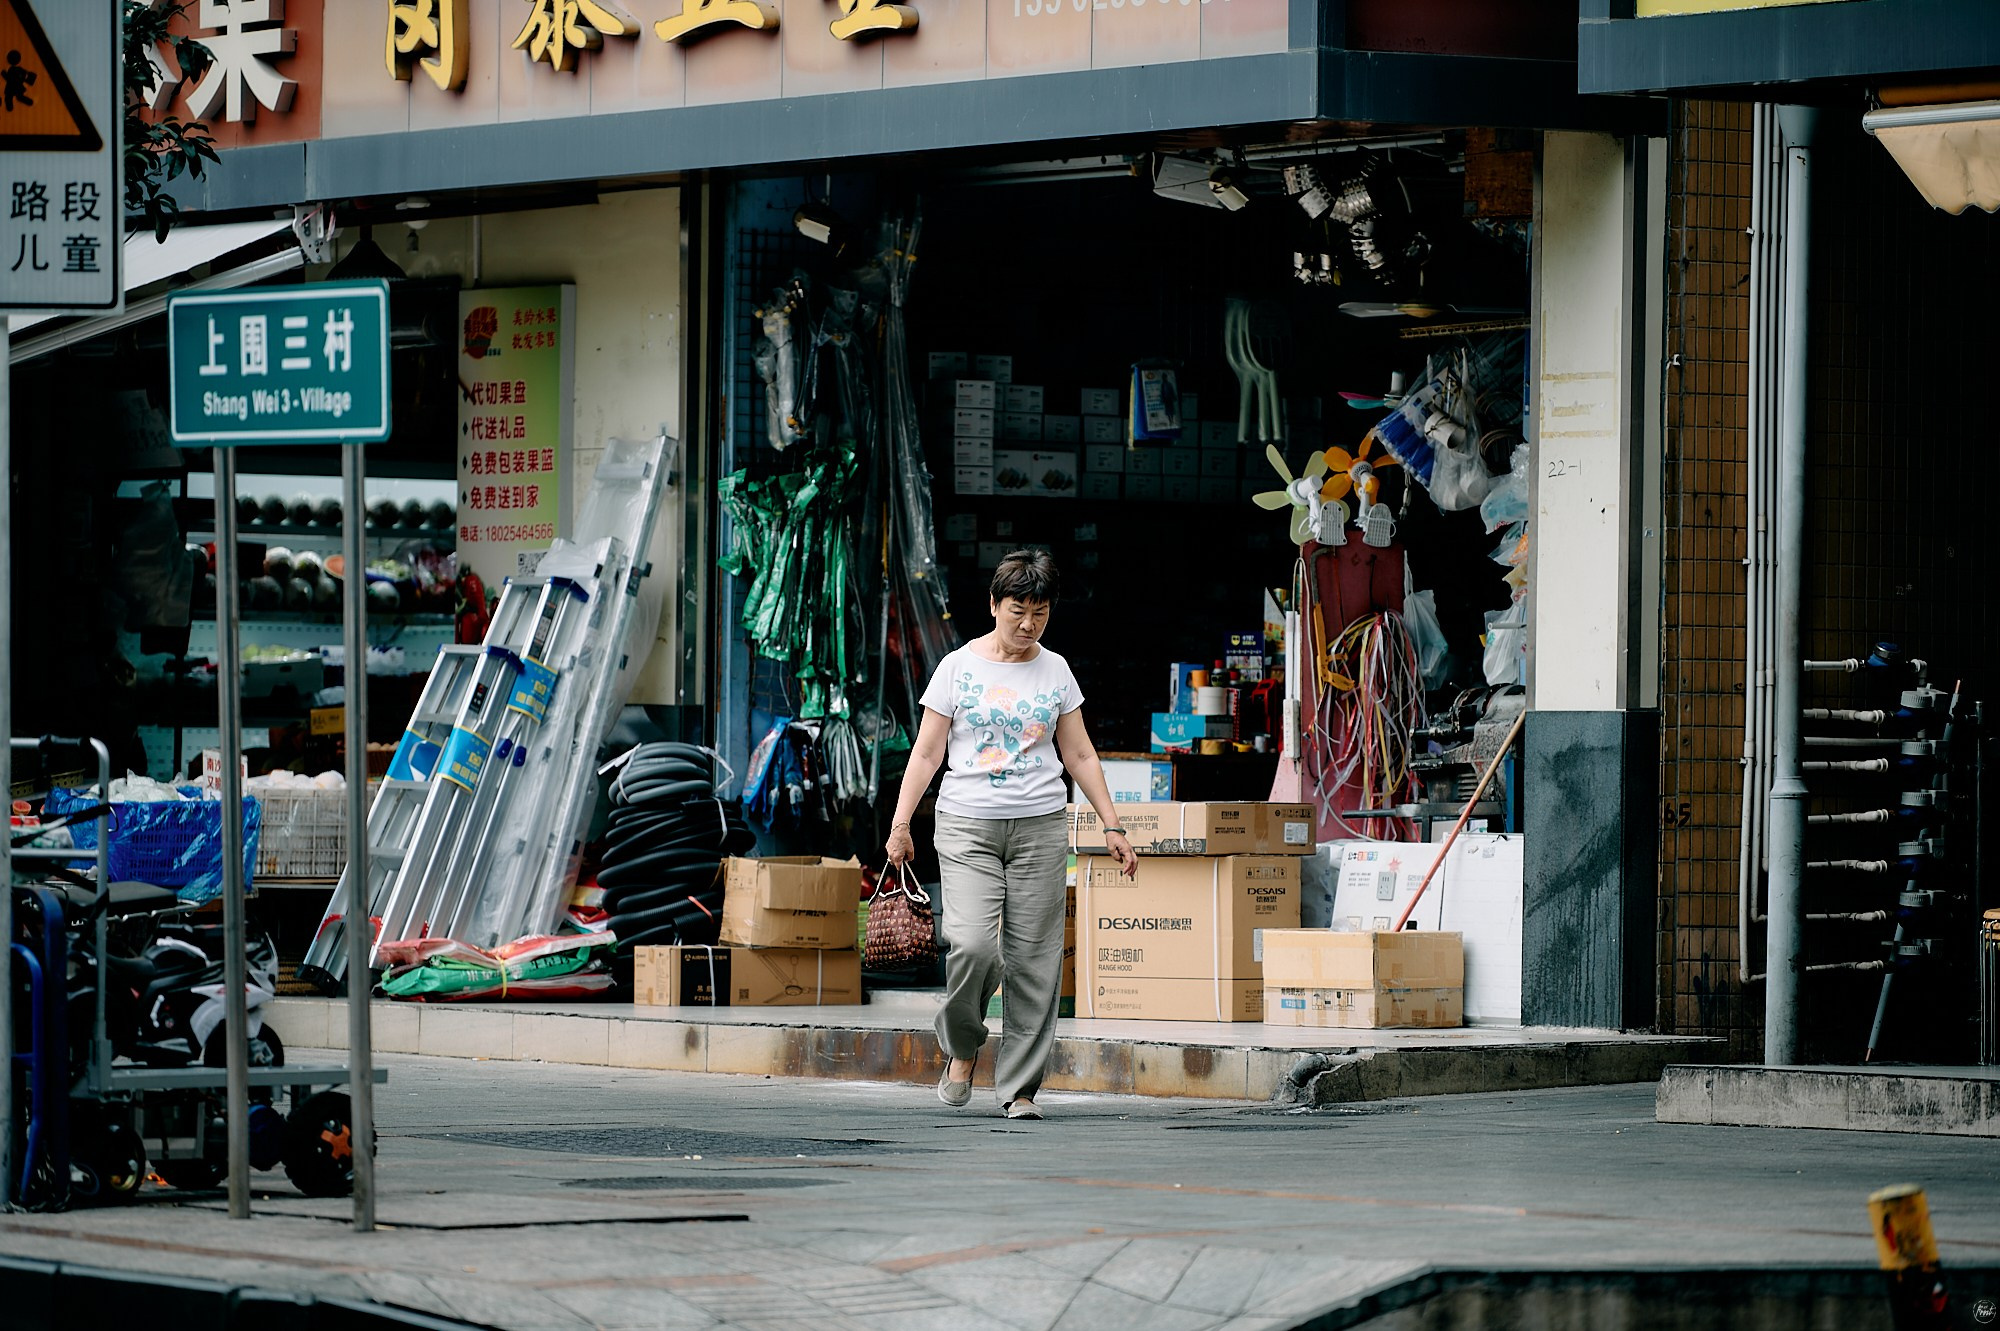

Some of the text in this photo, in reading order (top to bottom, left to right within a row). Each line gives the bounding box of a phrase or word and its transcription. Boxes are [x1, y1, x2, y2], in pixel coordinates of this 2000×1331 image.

[10, 181, 100, 222] 路段
[11, 233, 101, 272] 儿童
[200, 308, 355, 377] 上围三村
[203, 390, 248, 421] Shang
[252, 389, 280, 415] Wei
[471, 416, 525, 440] 代送礼品
[470, 448, 554, 475] 免费包装果篮
[1548, 459, 1582, 478] 22-1
[470, 485, 539, 510] 免费送到家
[1247, 887, 1286, 895] DESAISI
[1098, 948, 1144, 963] 吸油烟机
[1098, 964, 1133, 972] RANGE HOOD
